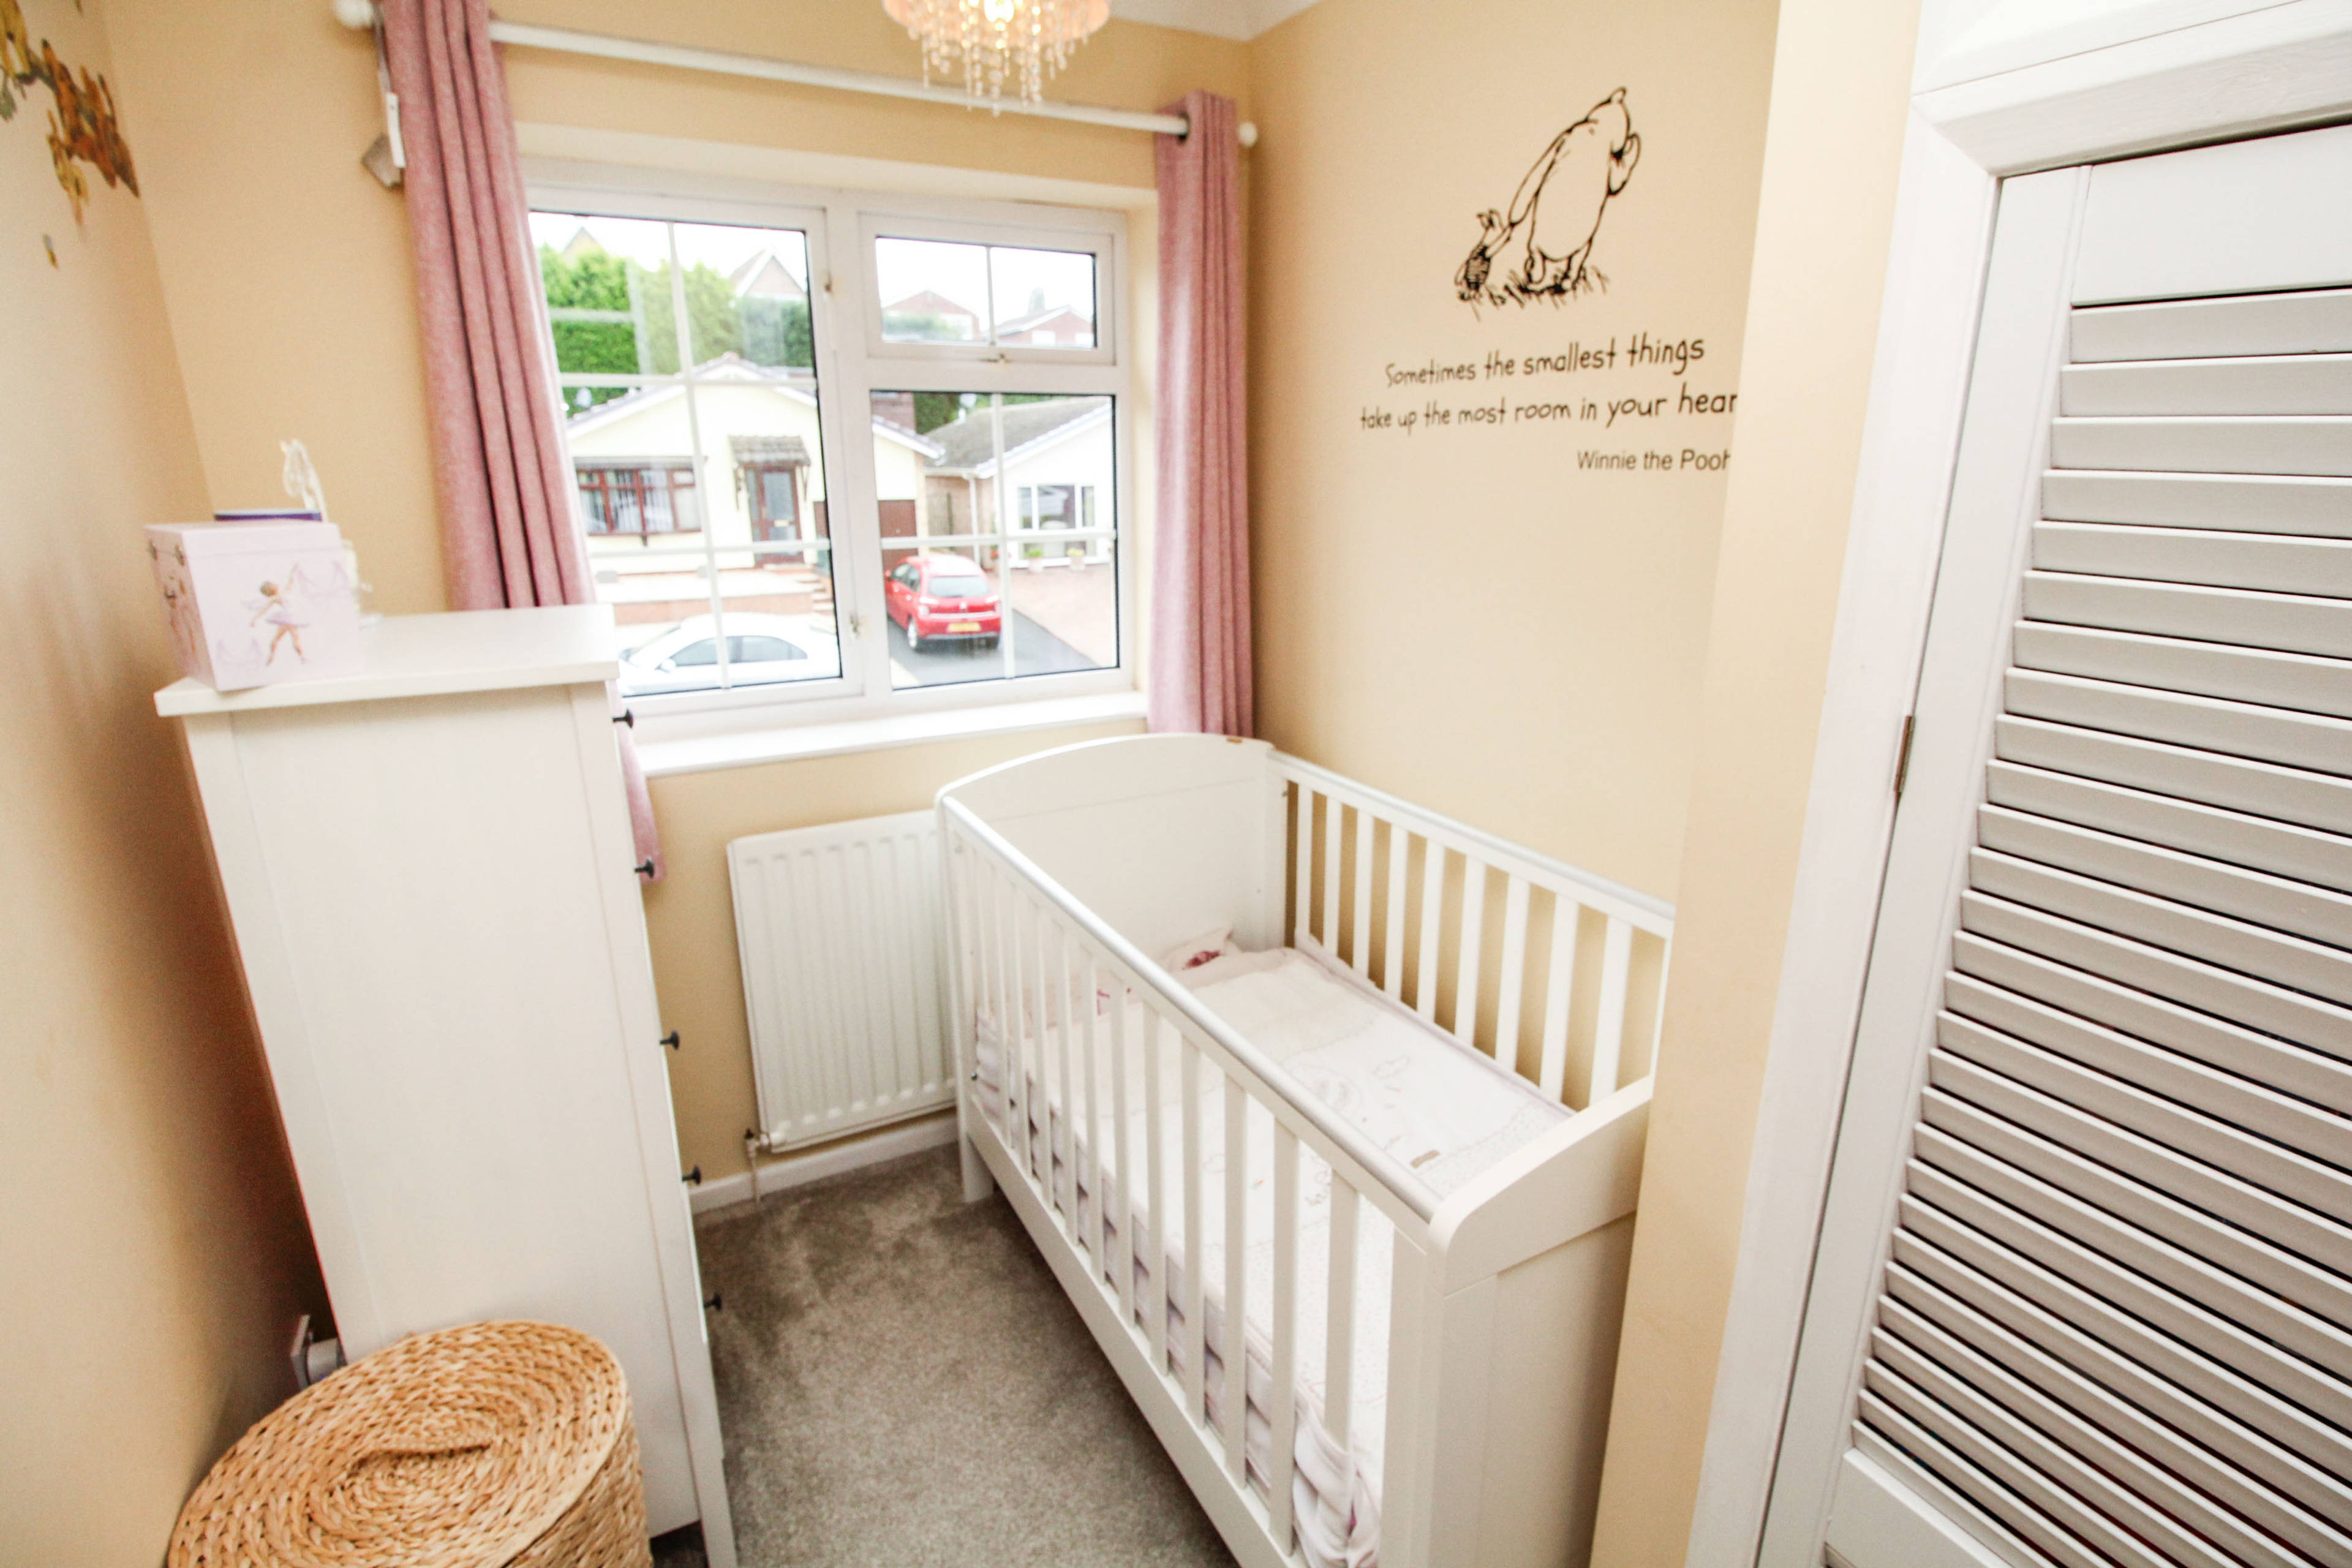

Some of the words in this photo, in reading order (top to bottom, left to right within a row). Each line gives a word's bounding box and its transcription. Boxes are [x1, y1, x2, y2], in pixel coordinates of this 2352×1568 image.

[1385, 358, 1476, 388] Sometimes
[1484, 349, 1515, 380] the
[1523, 337, 1616, 375] smallest
[1627, 332, 1705, 375] things
[1360, 406, 1391, 431] take
[1397, 410, 1417, 436] up
[1424, 400, 1451, 427] the
[1458, 397, 1505, 424] most
[1515, 404, 1571, 423] room
[1580, 398, 1597, 420] in
[1605, 398, 1667, 428] your
[1678, 382, 1738, 414] hear
[1577, 450, 1637, 470] Winnie
[1644, 450, 1673, 471] the
